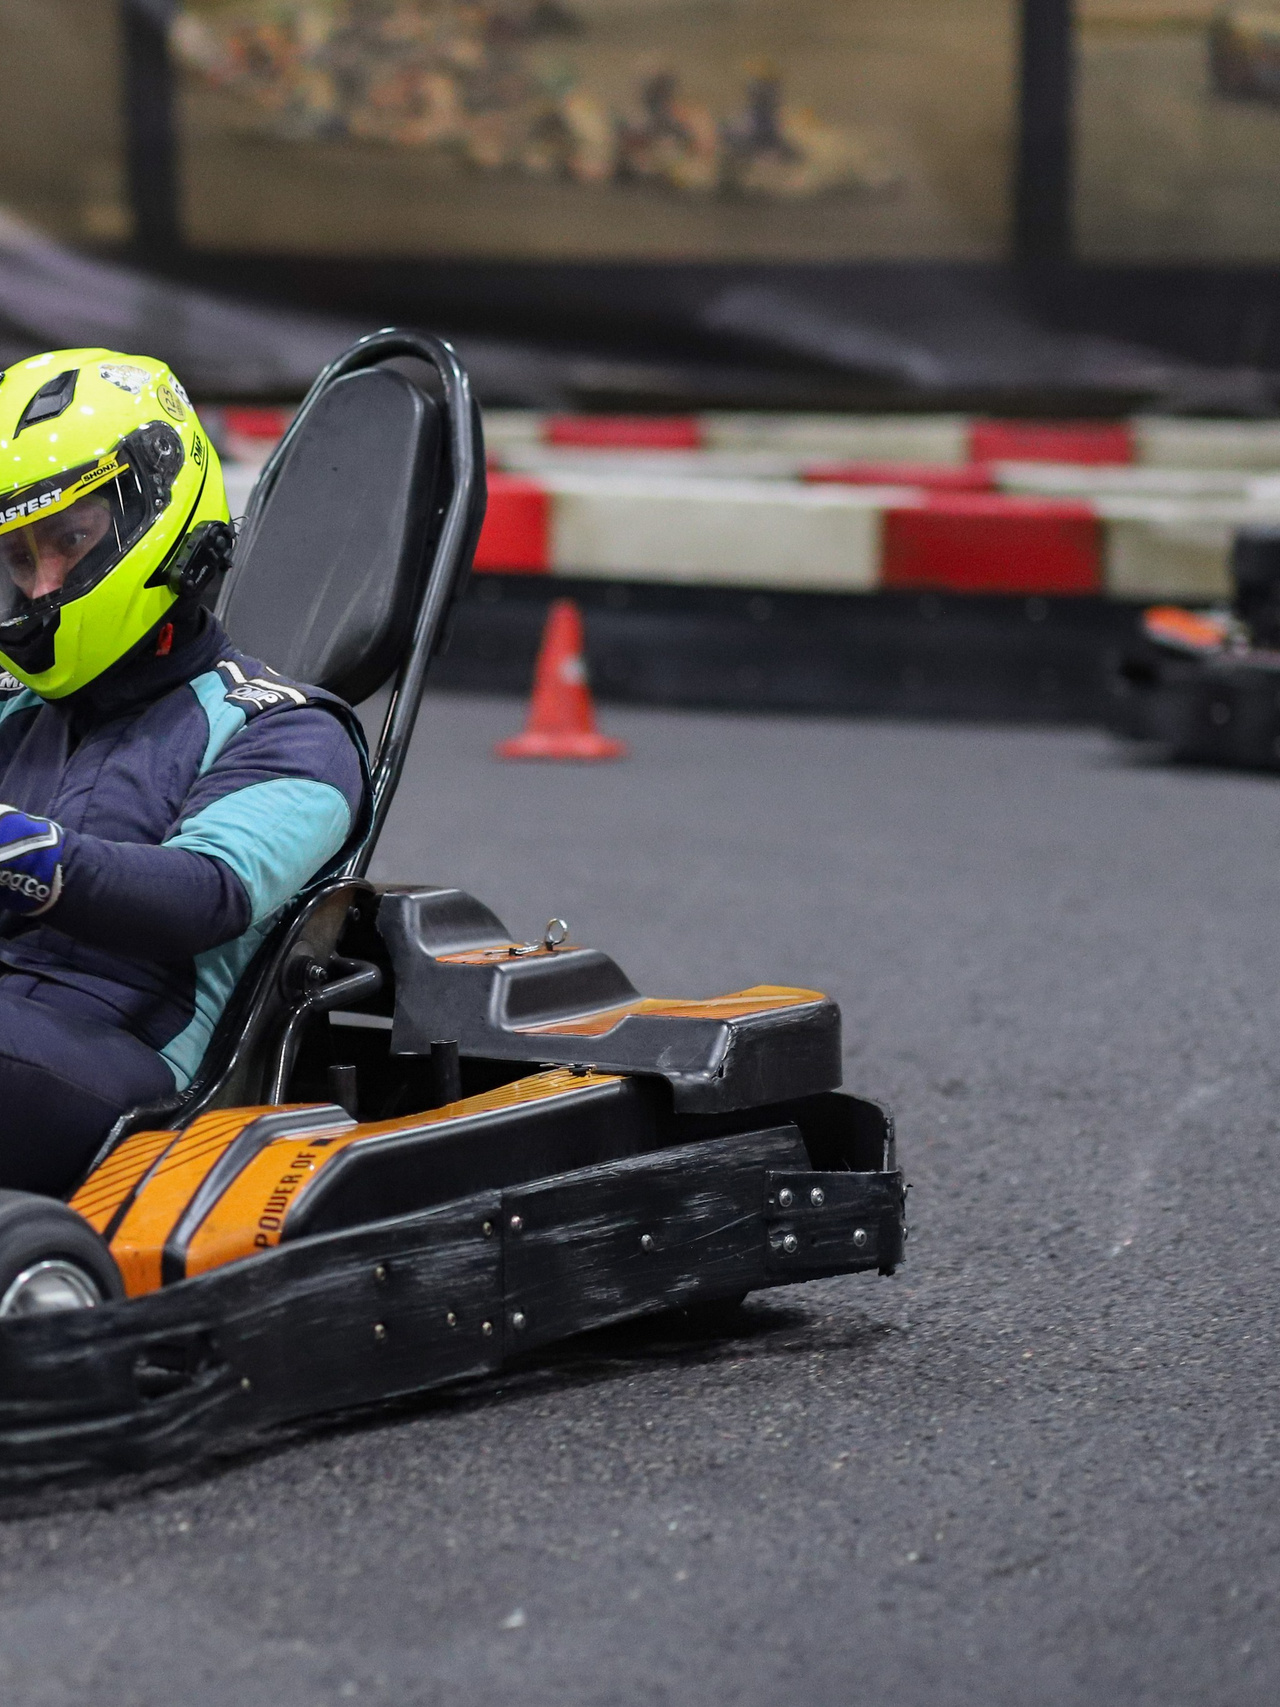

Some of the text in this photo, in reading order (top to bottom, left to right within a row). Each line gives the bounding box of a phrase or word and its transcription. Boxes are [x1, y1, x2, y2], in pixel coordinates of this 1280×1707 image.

[83, 460, 118, 482] SHONX
[232, 686, 279, 704] OMP
[253, 1152, 317, 1249] POWER OF
